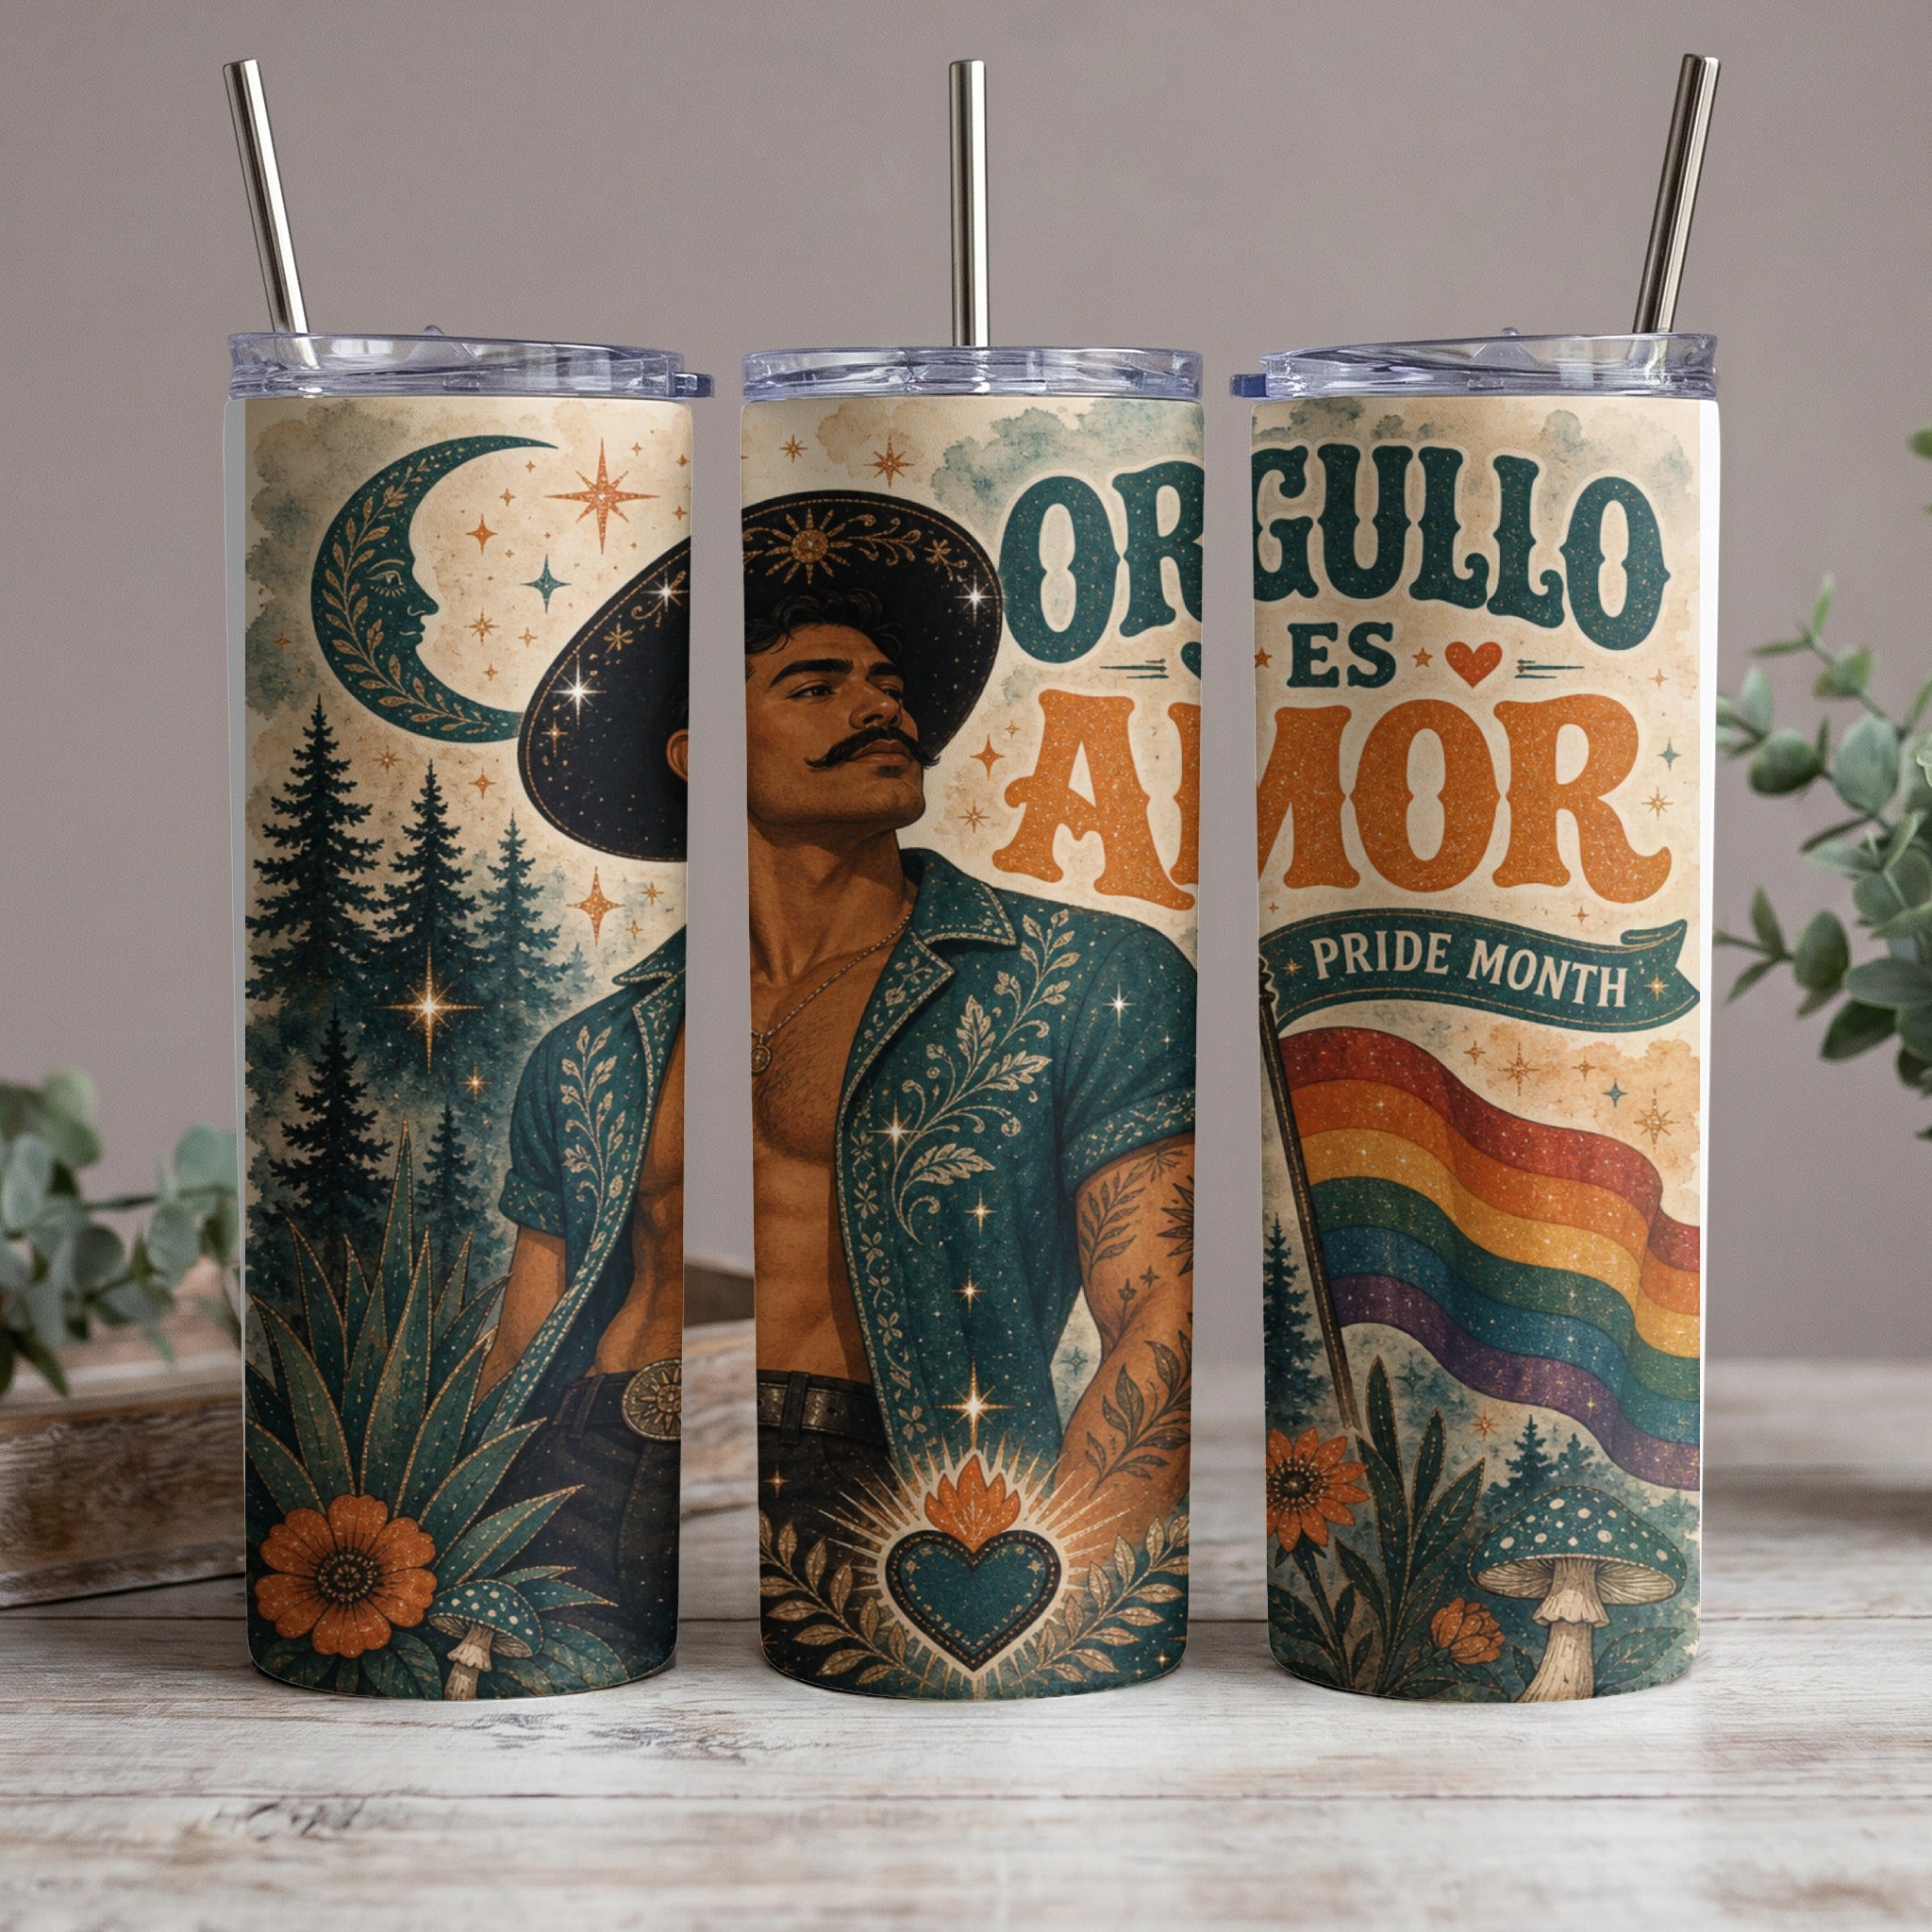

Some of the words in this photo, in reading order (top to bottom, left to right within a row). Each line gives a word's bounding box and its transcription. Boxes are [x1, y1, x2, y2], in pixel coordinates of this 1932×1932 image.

[1252, 443, 1671, 650] GULLO
[1287, 622, 1396, 688] ES
[992, 689, 1201, 911] A
[1310, 930, 1452, 980] PRIDE
[1467, 939, 1628, 1008] MONTH
